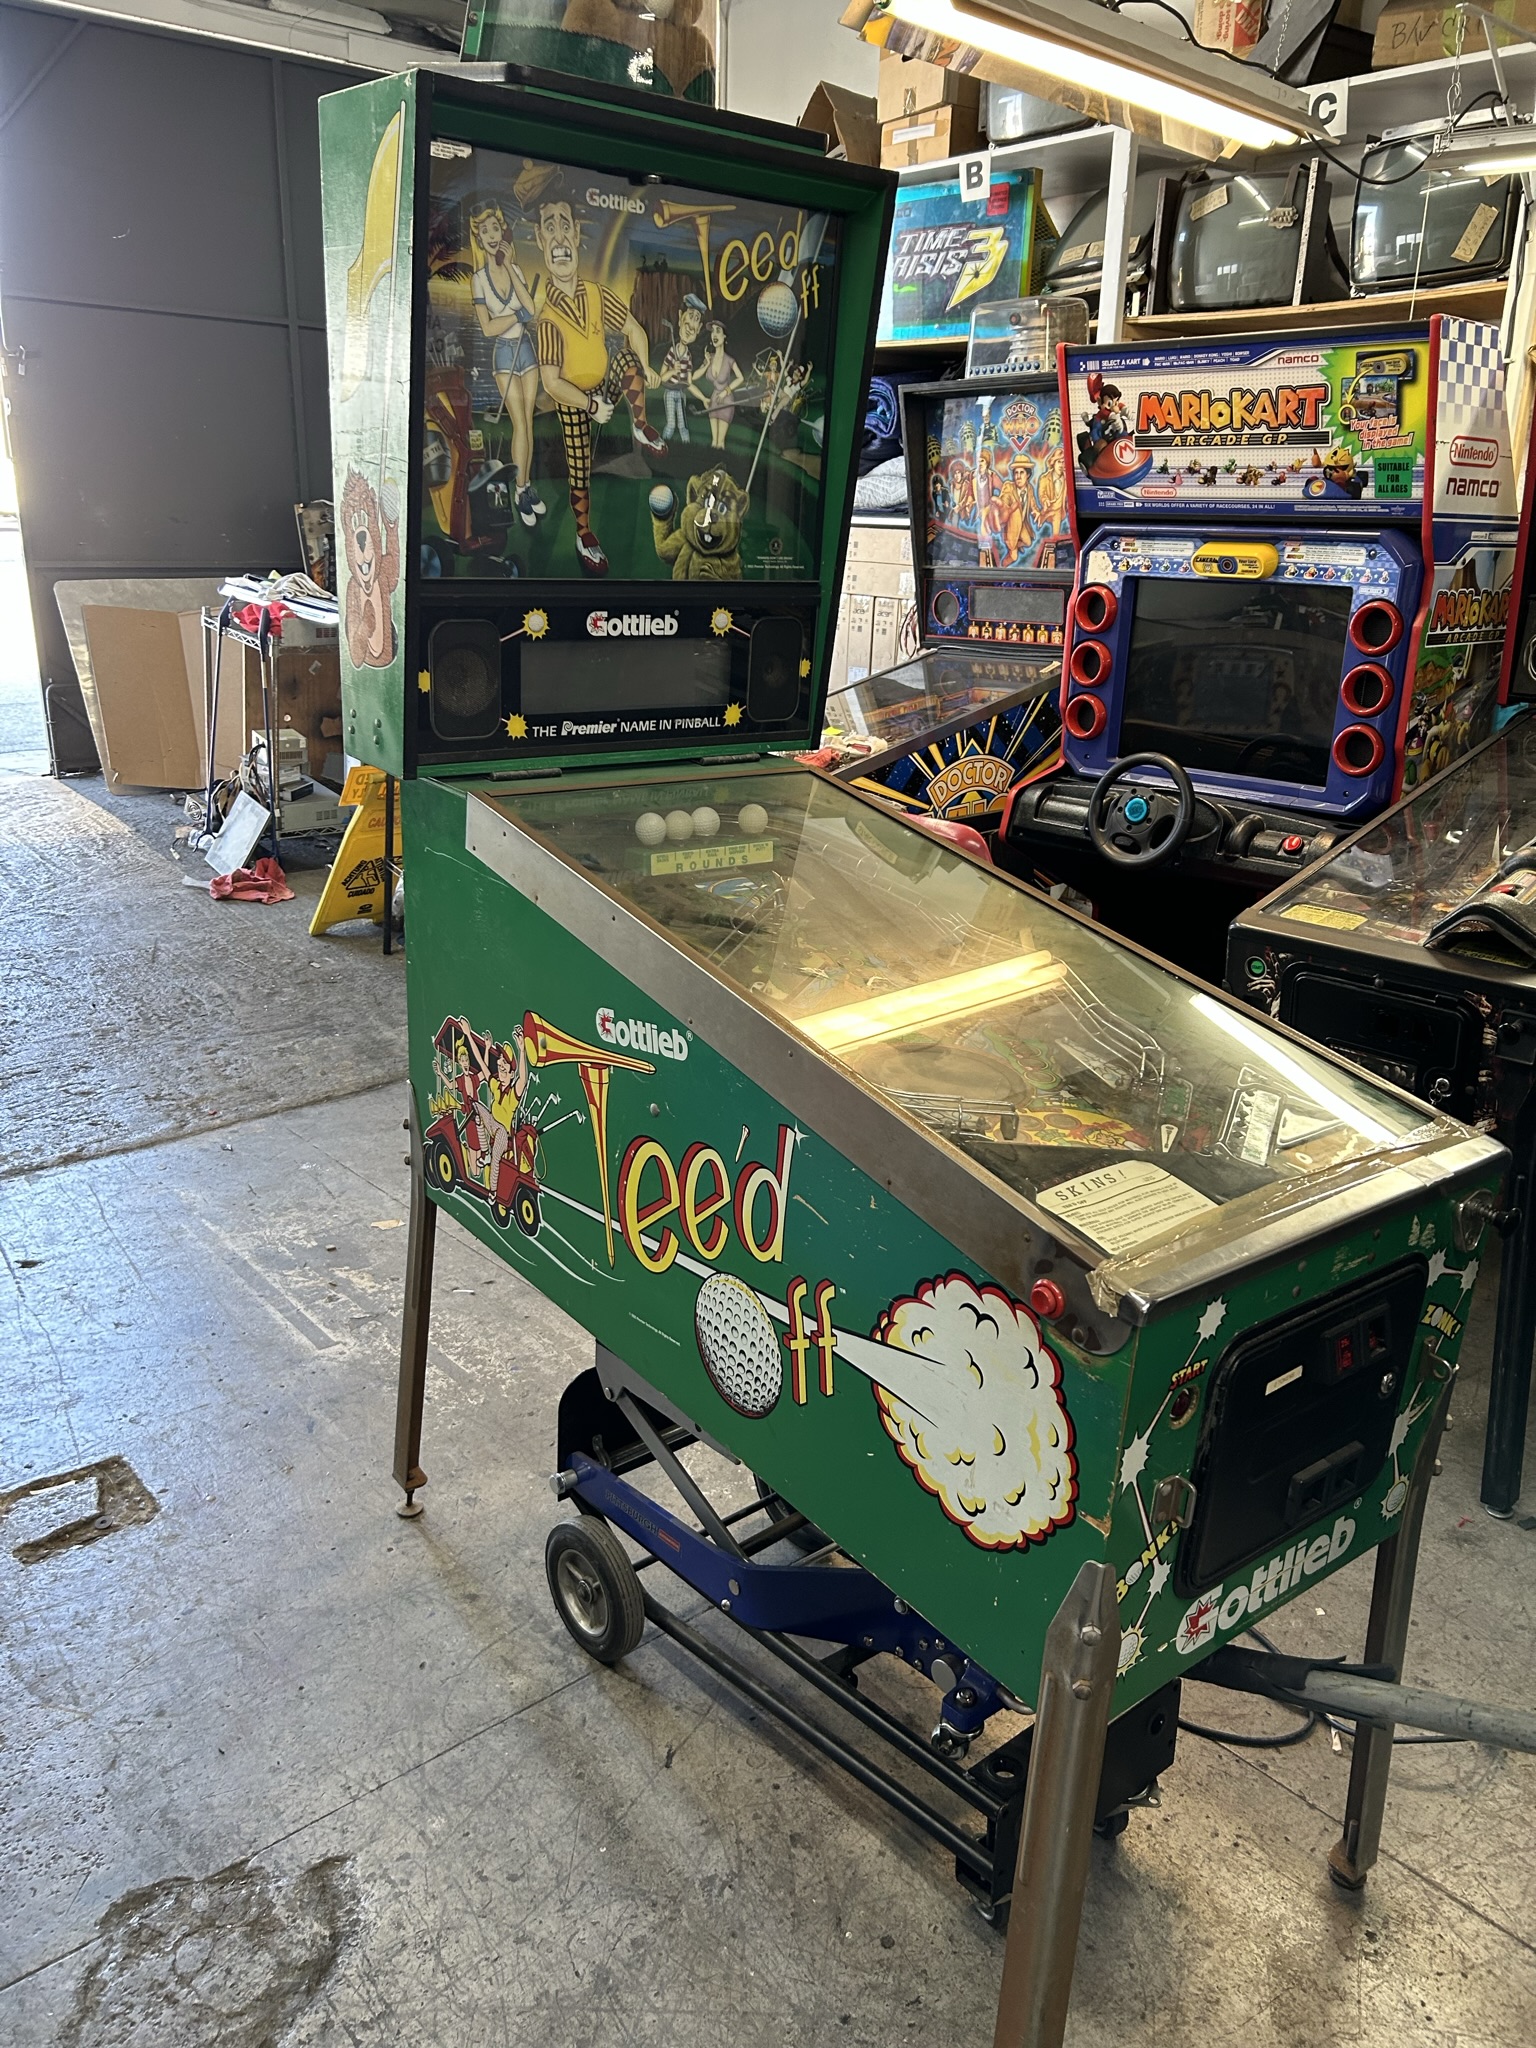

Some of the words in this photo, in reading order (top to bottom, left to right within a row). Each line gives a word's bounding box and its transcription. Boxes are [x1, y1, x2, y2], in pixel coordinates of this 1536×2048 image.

[1311, 92, 1338, 126] C
[966, 160, 984, 190] B
[586, 188, 646, 214] Gottlieb
[898, 227, 967, 254] TIME
[1102, 359, 1120, 367] SELECT
[1277, 354, 1319, 365] namco
[1006, 403, 1036, 416] DOCTOR
[1001, 417, 1040, 435] WHO
[1350, 418, 1369, 431] Your
[1359, 425, 1399, 440] displayed
[1172, 434, 1250, 446] ARCADE
[1262, 433, 1288, 445] GP
[1362, 439, 1371, 449] in
[1372, 438, 1386, 448] the
[1454, 444, 1496, 462] Nintendo
[1378, 462, 1410, 472] SUITABLE
[1387, 474, 1400, 482] FOR
[1144, 489, 1174, 497] Nintendo
[1378, 484, 1390, 493] ALL
[1391, 484, 1408, 493] AGES
[1446, 477, 1500, 498] namco
[877, 610, 893, 618] acer
[586, 611, 679, 636] Gottlieb
[1446, 632, 1483, 643] ARCADE
[532, 726, 557, 737] THE
[561, 720, 617, 736] Premier
[620, 719, 656, 732] NAME
[659, 719, 672, 730] IN
[674, 717, 721, 730] PINBALL
[933, 761, 1008, 803] DOCTOR
[676, 855, 749, 872] ROUNDS
[348, 888, 375, 898] CUIDADO
[596, 1008, 689, 1061] Gottlieb
[1420, 1303, 1462, 1340] ZONK!
[1170, 1359, 1208, 1390] START
[605, 1489, 658, 1536] PITTSBURGH
[1175, 1515, 1356, 1655] Gottlieb
